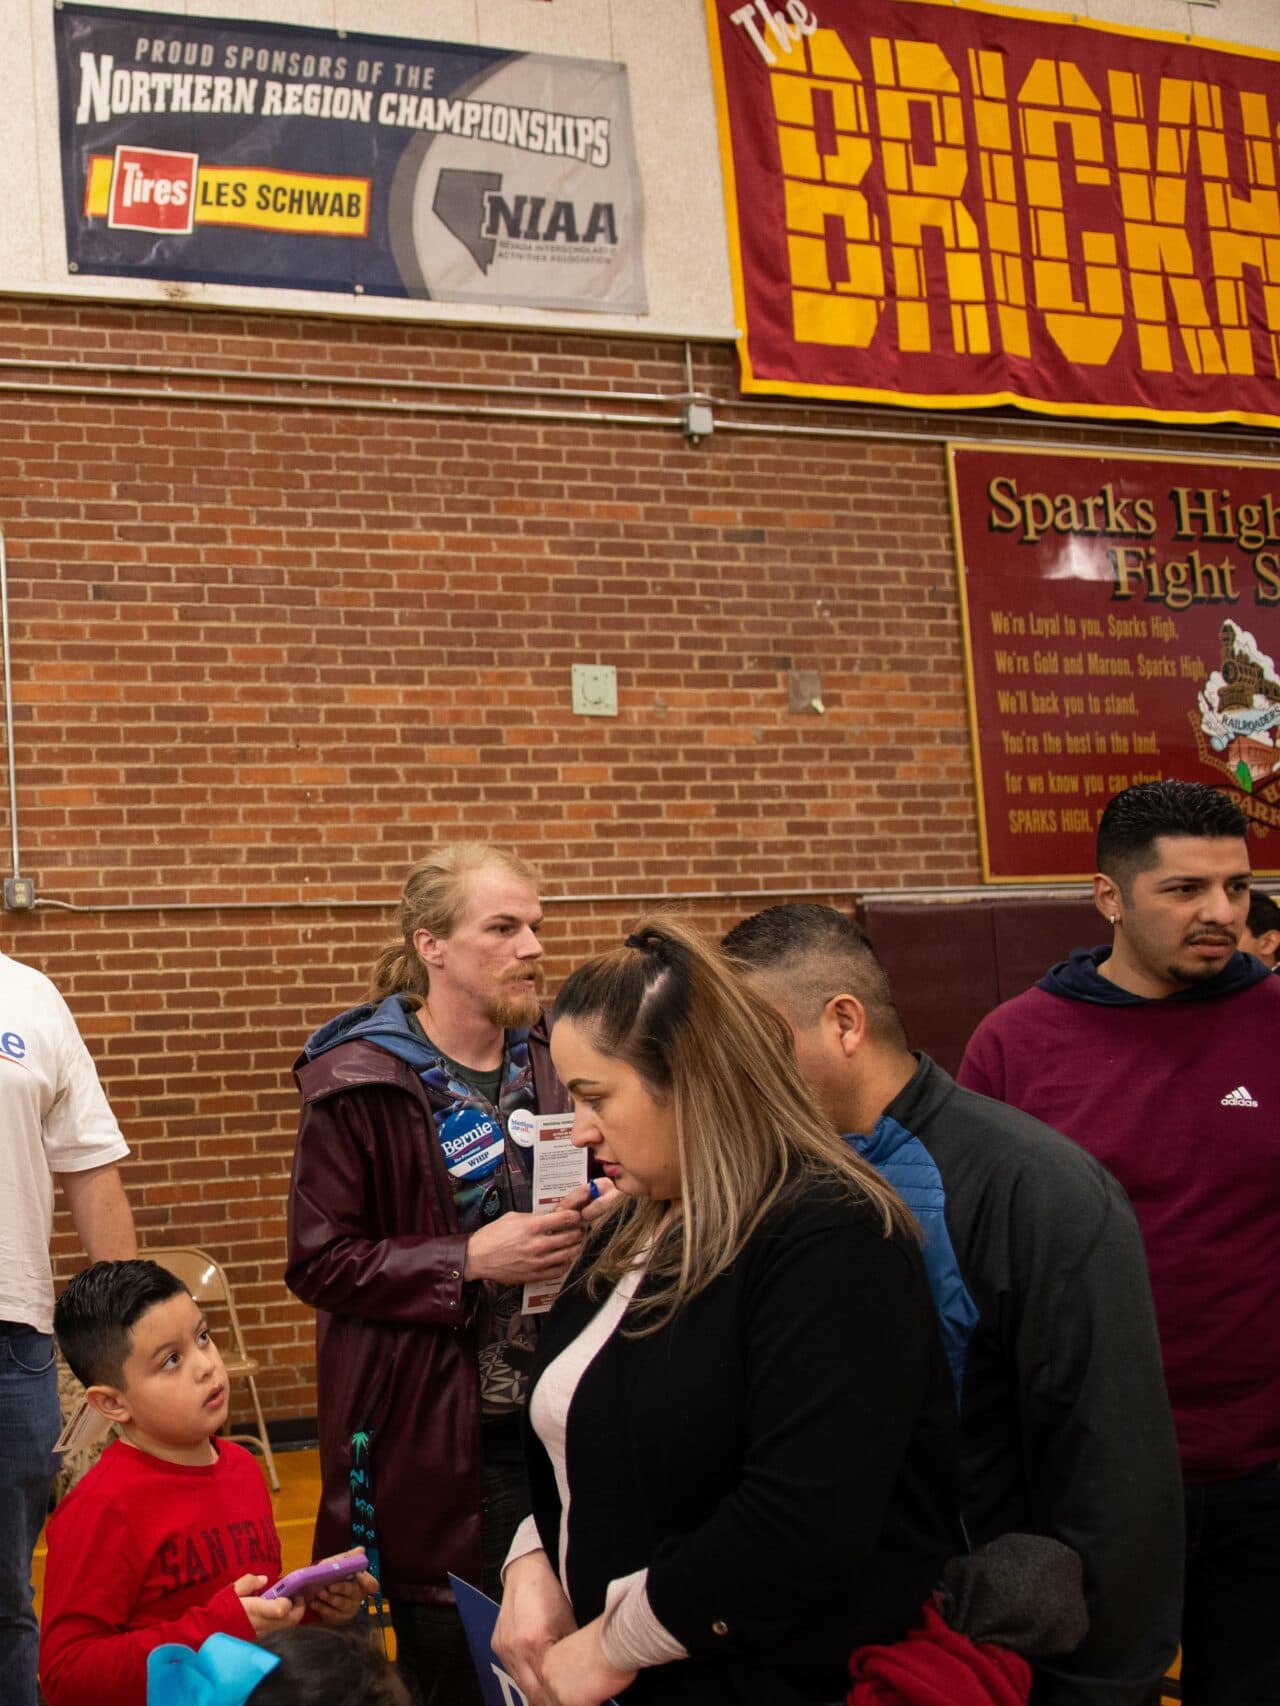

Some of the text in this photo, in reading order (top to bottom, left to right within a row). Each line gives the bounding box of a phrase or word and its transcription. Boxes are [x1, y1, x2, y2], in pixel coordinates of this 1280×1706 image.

[730, 0, 818, 65] The
[135, 38, 435, 90] PROUD SPONSORS OF THE
[75, 51, 611, 168] NORTHERN REGION CHAMPIONSHIPS
[122, 161, 188, 208] Tires
[200, 181, 362, 219] LES SCHWAB
[485, 195, 619, 245] NIAA
[988, 476, 1158, 542] Sparks
[1112, 546, 1241, 609] Fight
[991, 611, 1026, 635] We're
[1029, 611, 1061, 639] Loyal
[1063, 614, 1077, 636] to
[1107, 614, 1148, 641] Sparks
[995, 650, 1030, 675] We're
[1033, 650, 1060, 675] Gold
[1063, 651, 1084, 676] and
[1137, 653, 1177, 680] Sparks
[1031, 689, 1060, 715] back
[1063, 696, 1084, 719] you
[1088, 692, 1101, 715] to
[1043, 730, 1062, 755] the
[1065, 730, 1092, 755] best
[1095, 730, 1107, 755] in
[1110, 730, 1130, 755] the
[1005, 769, 1023, 794] for
[1027, 774, 1045, 794] we
[1048, 770, 1079, 794] know
[1083, 774, 1104, 797] you
[1108, 775, 1128, 794] can
[1008, 809, 1057, 834] SPARKS
[440, 1122, 493, 1157] Bernie
[467, 1151, 490, 1168] WHIP
